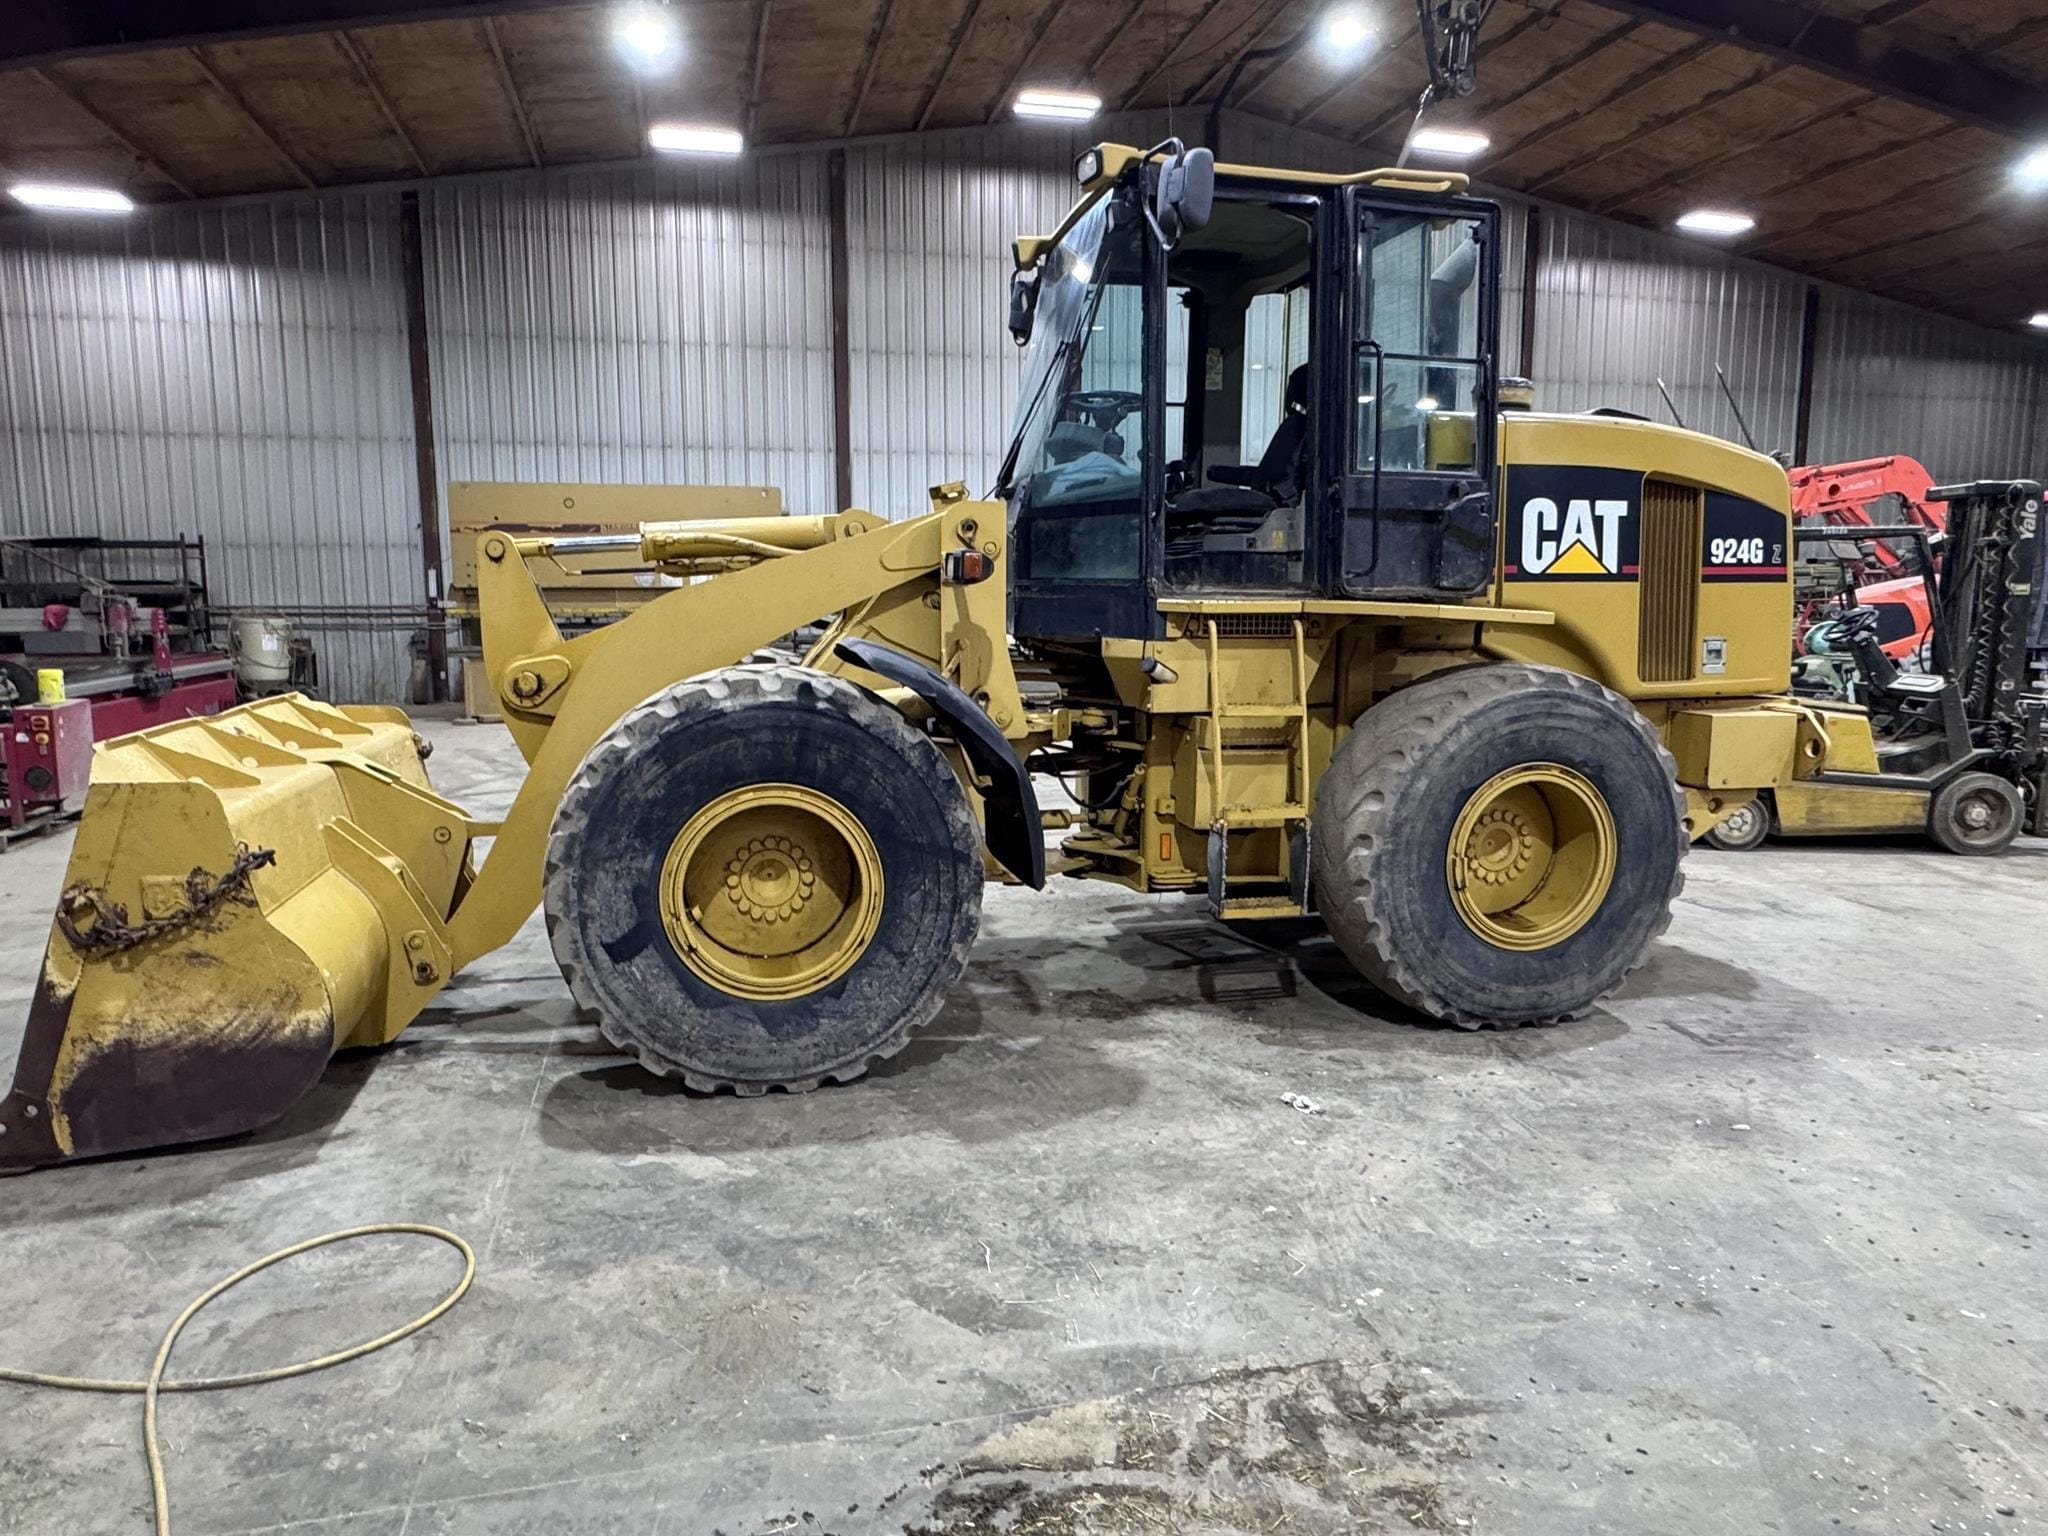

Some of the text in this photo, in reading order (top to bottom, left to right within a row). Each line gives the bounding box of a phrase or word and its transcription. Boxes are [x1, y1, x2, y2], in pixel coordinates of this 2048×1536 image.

[1521, 497, 1628, 575] CAT
[2019, 499, 2038, 540] Yale
[1710, 537, 1764, 564] 924G
